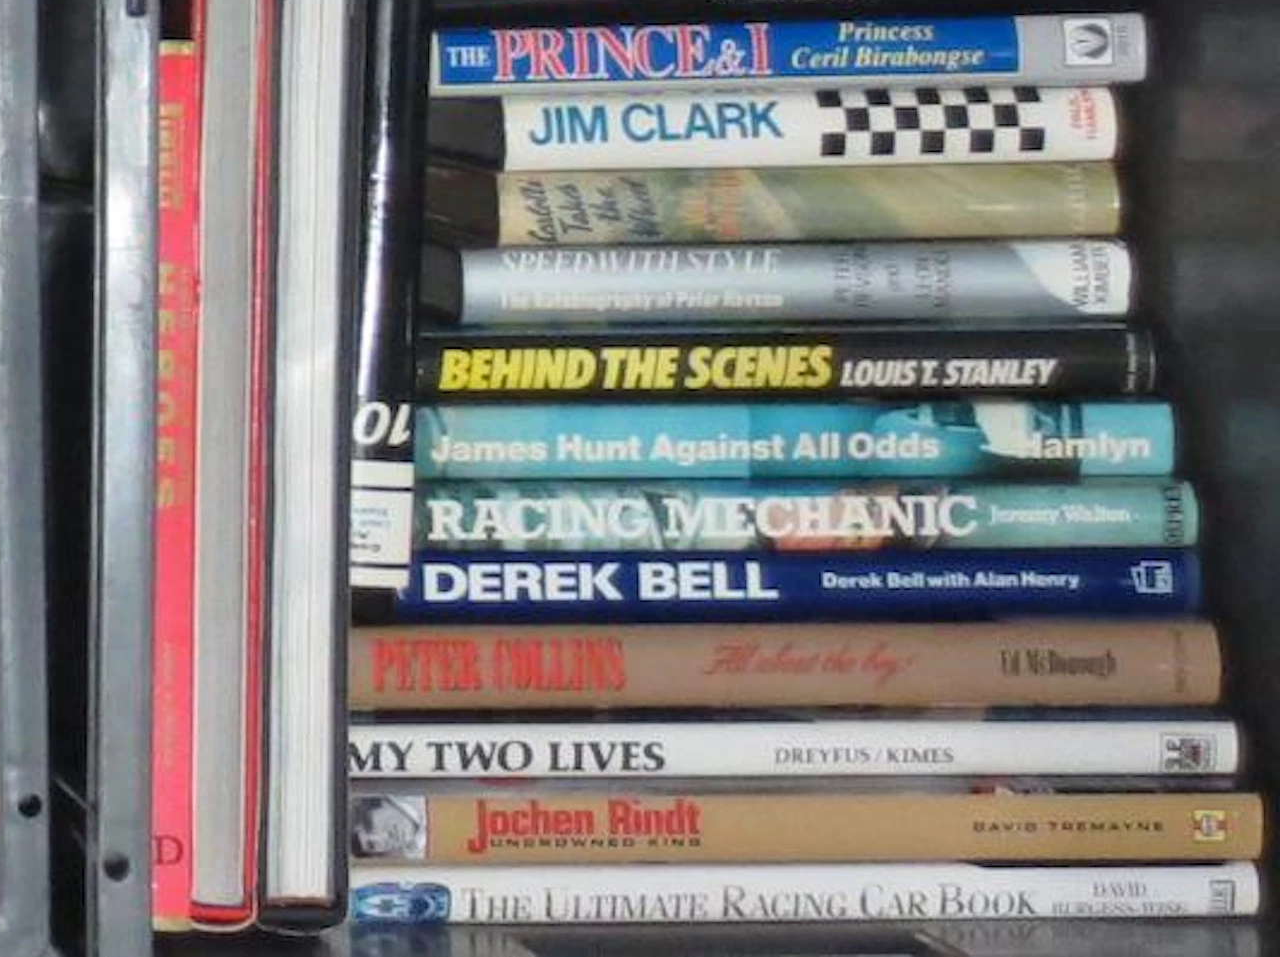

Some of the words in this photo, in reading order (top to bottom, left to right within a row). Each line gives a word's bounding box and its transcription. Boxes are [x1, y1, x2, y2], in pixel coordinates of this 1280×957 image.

[838, 22, 935, 42] Princess
[792, 46, 849, 69] Ceril
[854, 45, 985, 68] Birabongse
[529, 105, 610, 145] JIM
[620, 101, 784, 141] CLARK
[439, 347, 597, 390] BEHIND
[601, 347, 680, 390] THE
[684, 346, 833, 389] SCENES
[430, 437, 547, 463] James
[556, 435, 641, 461] Hunt
[648, 433, 784, 467] Against
[792, 431, 838, 460] All
[847, 430, 940, 459] Odds
[426, 497, 652, 542] RACING
[662, 492, 979, 540] MECHANIC
[422, 563, 624, 602] DEREK
[638, 562, 780, 600] BELL
[821, 572, 883, 589] Derek
[887, 572, 925, 588] Bell
[927, 572, 970, 588] with
[974, 572, 1018, 588] Alan
[1021, 572, 1079, 590] Henry
[348, 742, 413, 772] MY
[429, 741, 533, 772] TWO
[548, 742, 666, 772] LIVES
[467, 798, 594, 854] Jochen
[608, 798, 700, 835] Rindt
